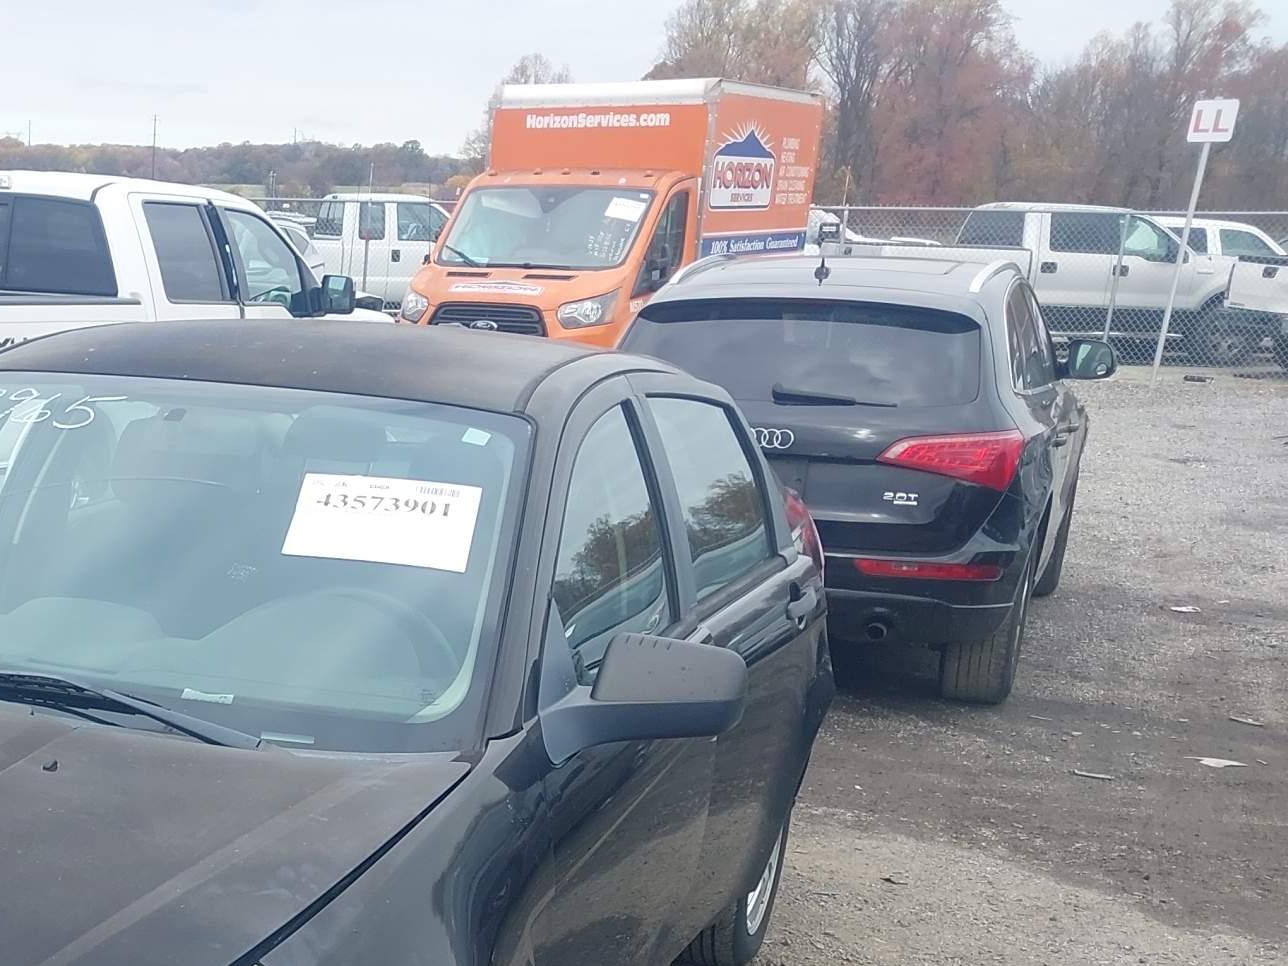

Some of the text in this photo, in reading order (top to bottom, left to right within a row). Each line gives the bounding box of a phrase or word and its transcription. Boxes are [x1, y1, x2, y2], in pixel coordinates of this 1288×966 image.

[525, 112, 671, 129] HorizonServices.com
[1192, 108, 1230, 134] LL
[712, 160, 774, 190] HORIZON
[710, 234, 799, 255] 100% Satisfaction Guaranteed
[316, 493, 451, 517] 43573901
